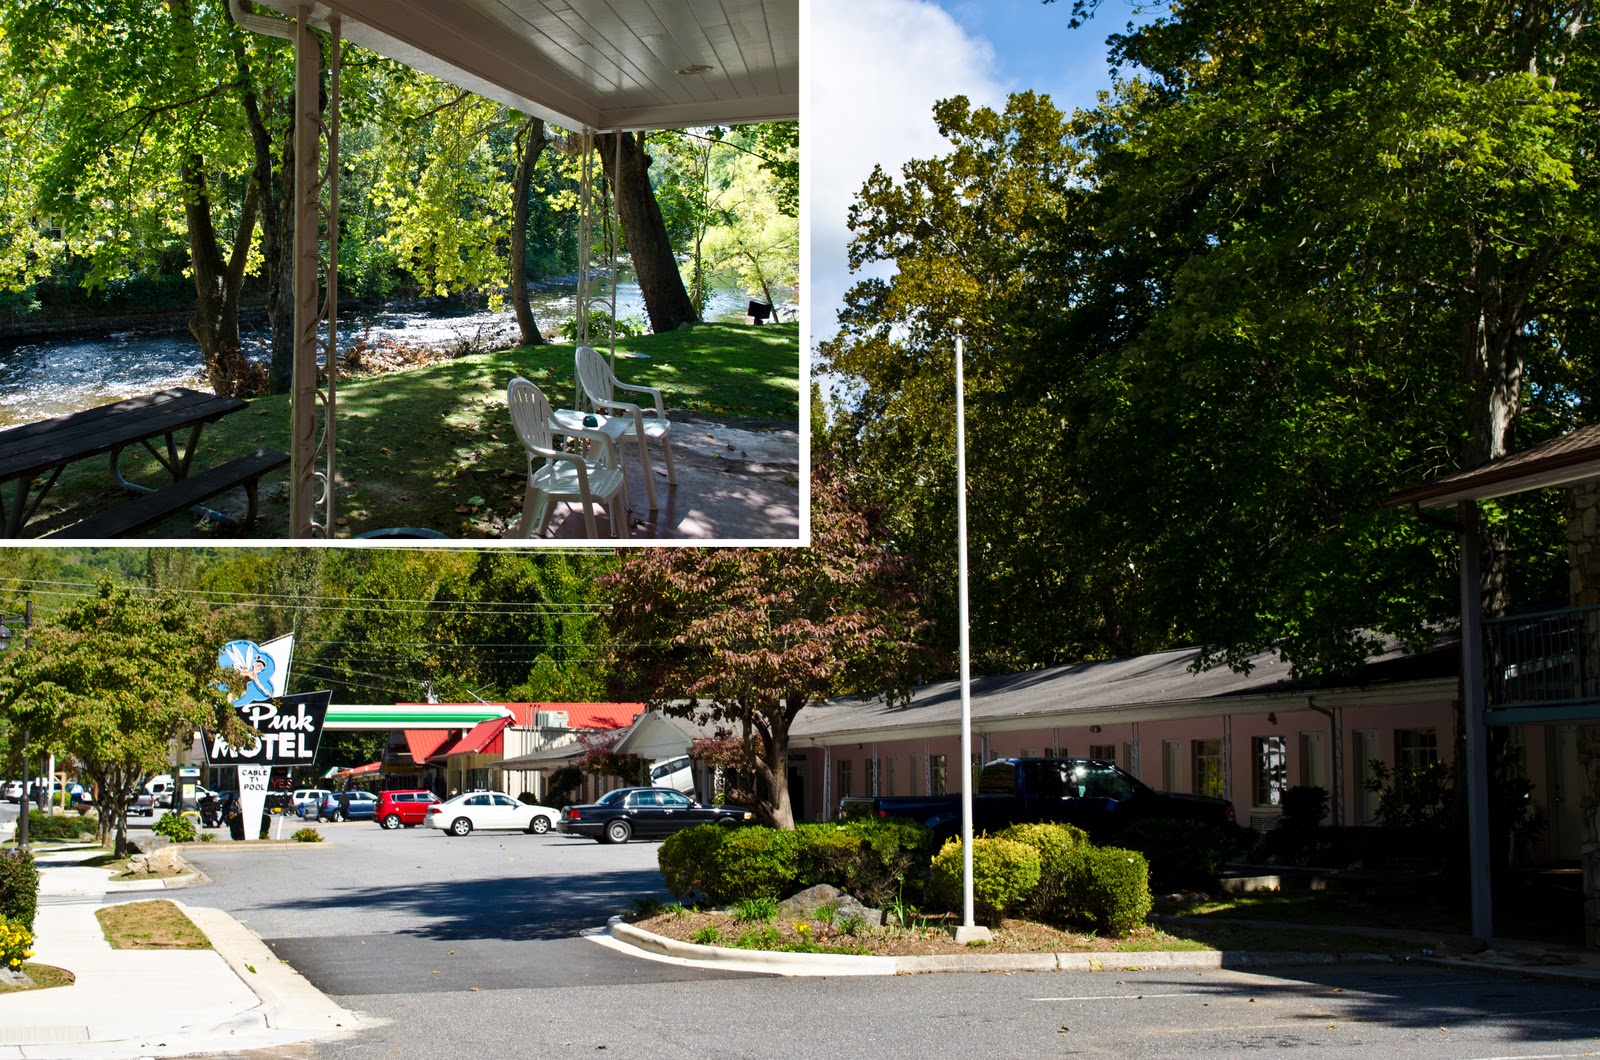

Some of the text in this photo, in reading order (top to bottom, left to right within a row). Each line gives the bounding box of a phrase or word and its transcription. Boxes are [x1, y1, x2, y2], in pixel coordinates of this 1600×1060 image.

[241, 702, 315, 732] Pink
[243, 783, 266, 791] POOL
[271, 778, 293, 790] YES
